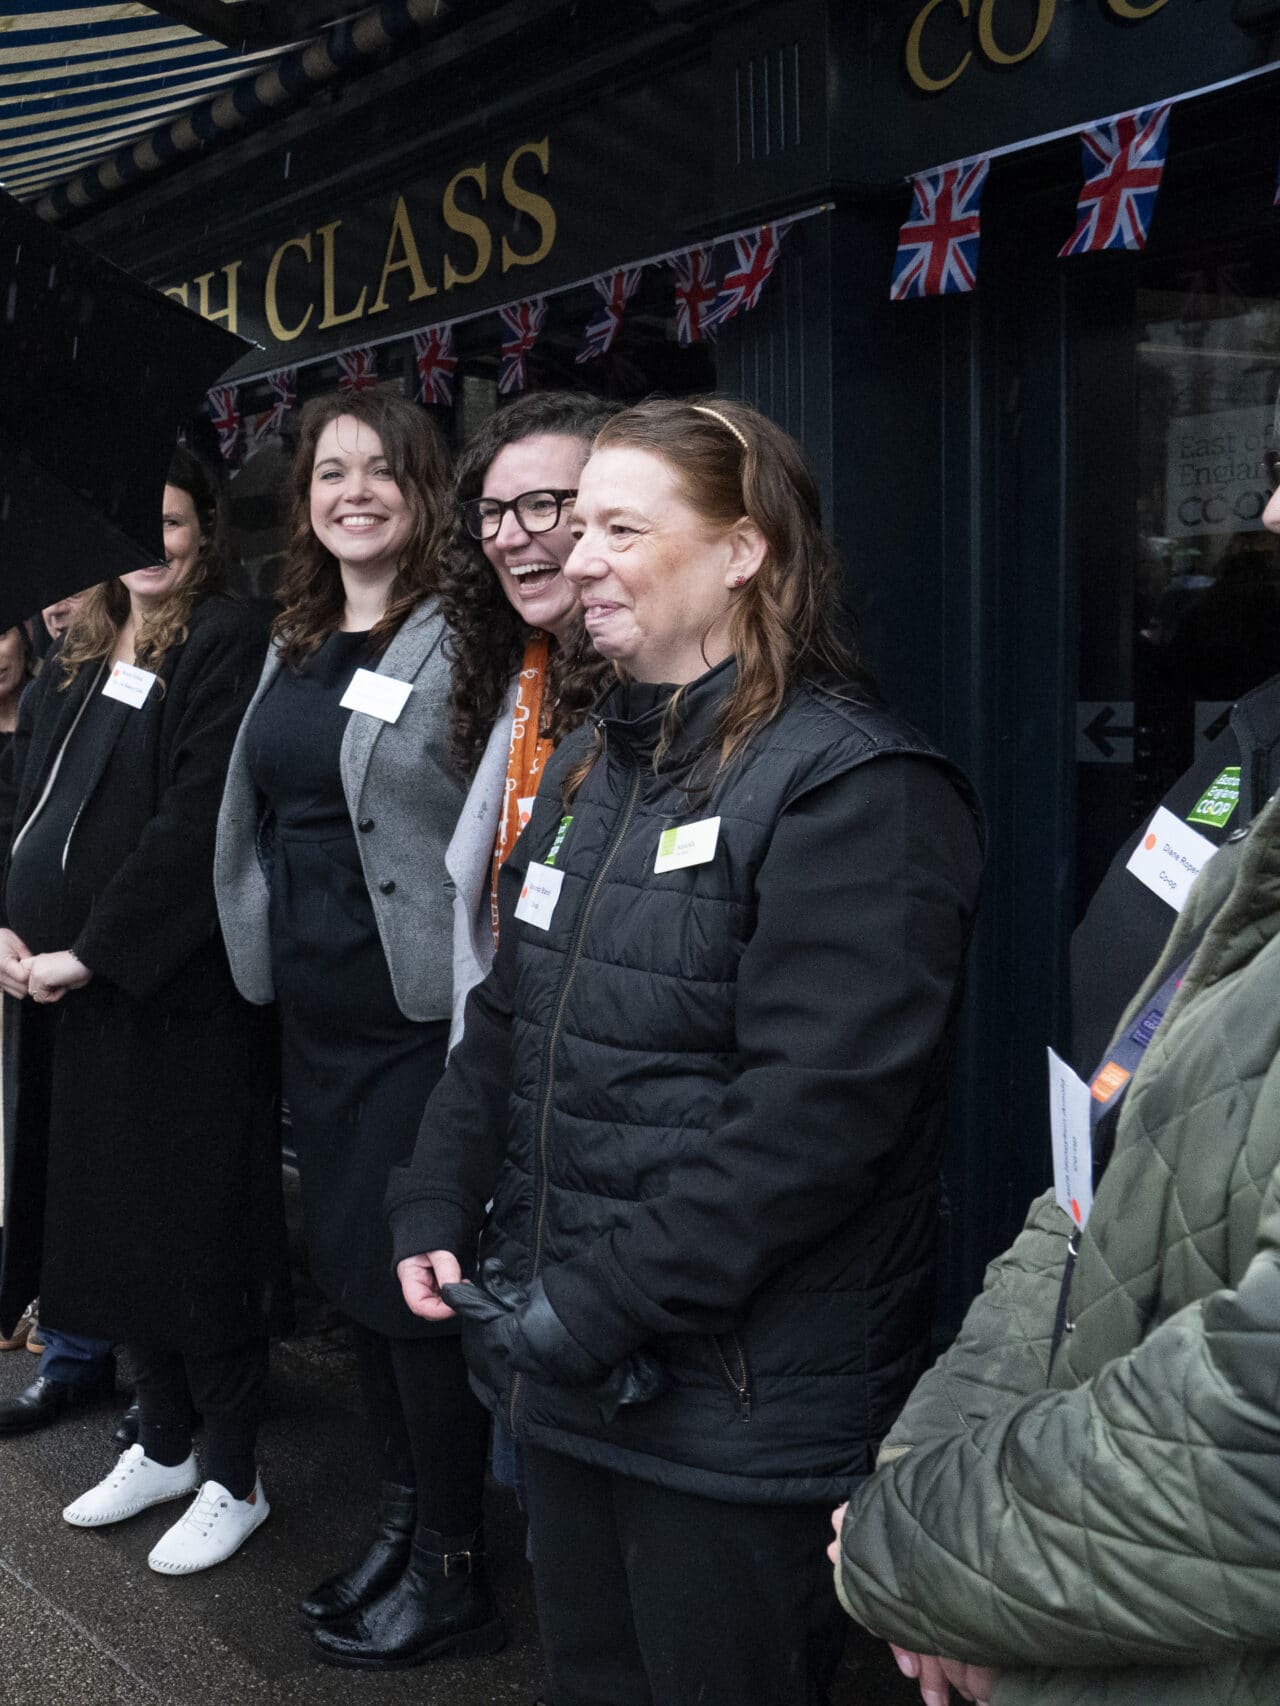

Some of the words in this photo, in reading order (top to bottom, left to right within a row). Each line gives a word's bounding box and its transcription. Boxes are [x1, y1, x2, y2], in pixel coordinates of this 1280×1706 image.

[264, 136, 558, 342] CLASS
[1181, 431, 1235, 459] East
[1180, 455, 1265, 486] Englan
[1178, 490, 1273, 527] COO
[1162, 843, 1180, 863] Diane
[1159, 870, 1177, 890] Co-op
